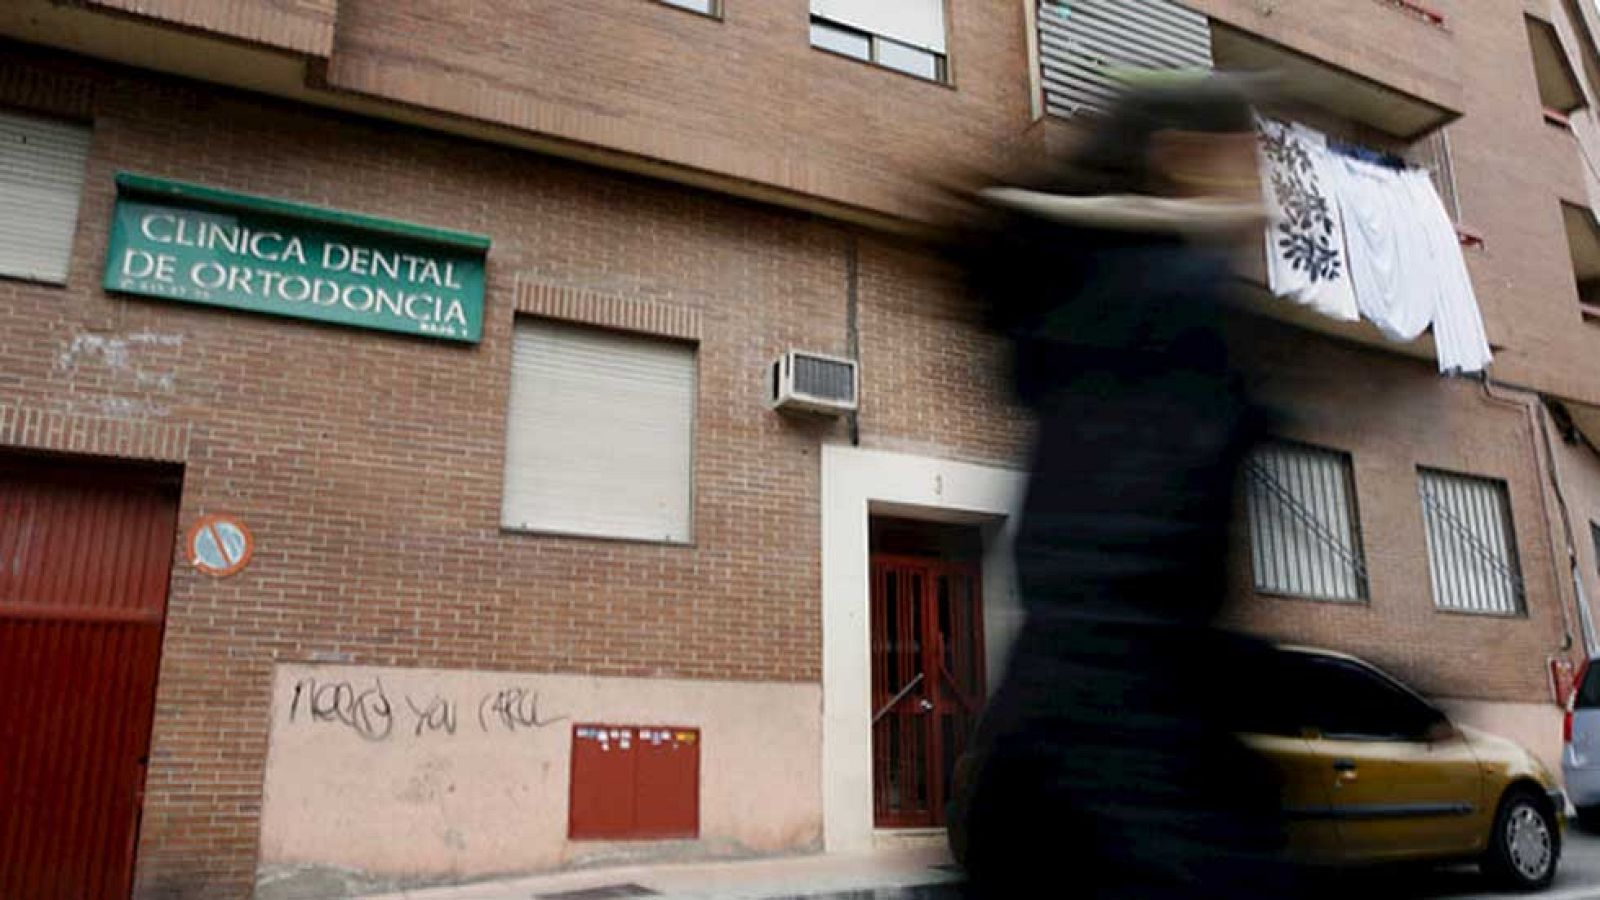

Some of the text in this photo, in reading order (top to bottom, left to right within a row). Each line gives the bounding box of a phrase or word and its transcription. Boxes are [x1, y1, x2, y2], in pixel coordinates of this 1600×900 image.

[122, 248, 176, 282] DE
[190, 260, 467, 326] ORTODONCIA
[141, 213, 462, 289] CLINICA DENTAL
